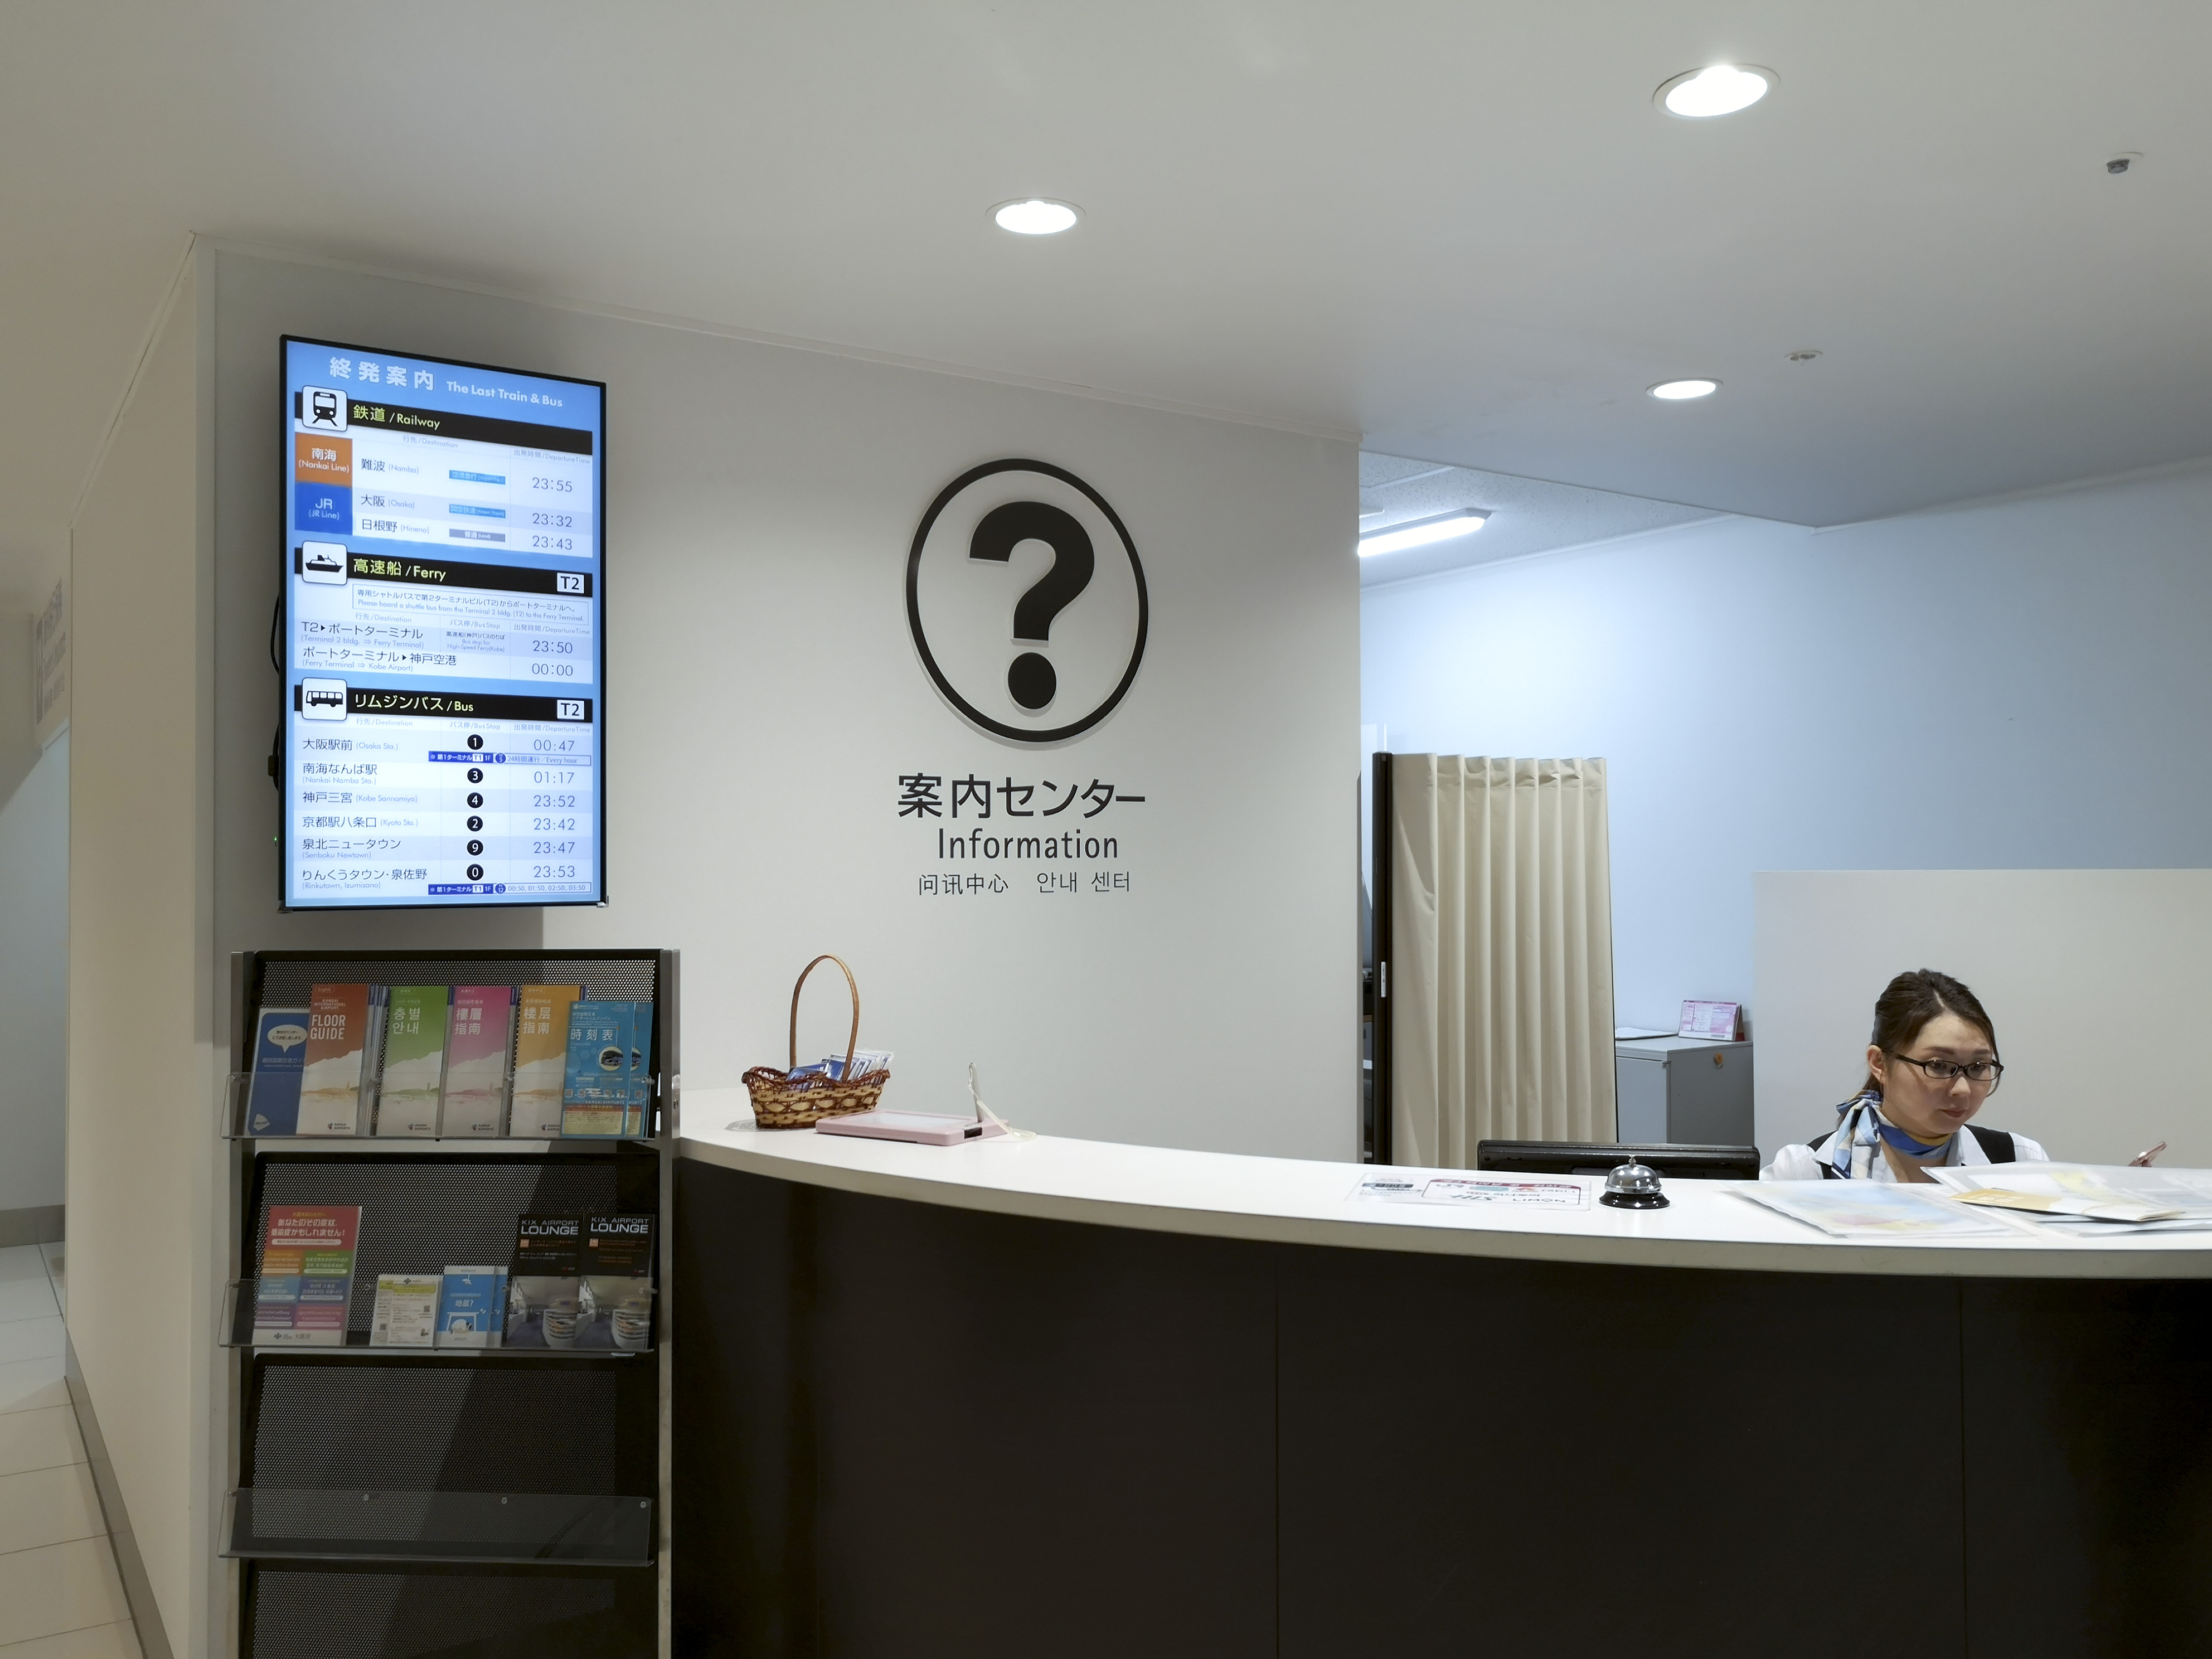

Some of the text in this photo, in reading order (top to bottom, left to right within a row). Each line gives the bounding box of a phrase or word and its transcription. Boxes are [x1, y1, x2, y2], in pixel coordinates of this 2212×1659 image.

[329, 357, 433, 390] 終発案内
[447, 381, 562, 407] The Last Train & Bus
[312, 448, 337, 462] 南海
[299, 459, 350, 473] (Nankai Line)
[361, 458, 419, 474] 難波 (Namba)
[532, 477, 573, 492] 23:55
[316, 498, 333, 510] JR
[361, 494, 415, 509] 大阪 (Osaka)
[309, 509, 339, 521] (JR Line)
[532, 513, 573, 527] 23:32
[362, 518, 429, 534] 日根野 (Hineno)
[532, 535, 573, 550] 23:43
[560, 576, 579, 590] T2
[465, 607, 490, 615] Terminal
[497, 609, 512, 618] bldg.
[329, 623, 423, 639] ポートターミナル
[302, 634, 334, 643] (Terminal
[343, 637, 360, 646] bldg.
[374, 639, 390, 648] Ferry
[392, 640, 424, 649] Terminal)
[532, 641, 573, 654] 23:50
[303, 647, 457, 666] ポートターミナル 神戸空港
[303, 659, 322, 668] (Ferry
[389, 663, 413, 672] Airport)
[532, 663, 573, 676] 00:00
[560, 702, 579, 716] T2
[303, 739, 352, 751] 大阪駅前
[533, 739, 575, 751] 00:47
[303, 763, 377, 775] 南海なんば駅
[534, 771, 574, 783] 01:17
[303, 792, 352, 803] 神戸三宮
[533, 795, 575, 807] 23:52
[898, 773, 1146, 819] 案内センター
[303, 816, 376, 828] 京都駅八条口
[533, 818, 575, 830] 23:42
[303, 838, 401, 850] 泉北ニュータウン
[533, 842, 575, 853] 23:47
[939, 828, 1118, 859] Information
[303, 869, 427, 880] りんくうタウン・泉佐野
[533, 866, 575, 877] 23:53
[919, 873, 1008, 895] 问讯中心
[1037, 871, 1130, 893] 안내 센터
[523, 1007, 551, 1020] 楼层
[312, 1015, 346, 1026] FLOOR
[310, 1027, 345, 1040] GUIDE
[454, 1022, 481, 1035] 指南
[522, 1021, 550, 1034] 指南
[570, 1029, 613, 1041] 時刻表
[521, 1225, 579, 1235] LOUNGE
[590, 1223, 648, 1233] LOUNGE
